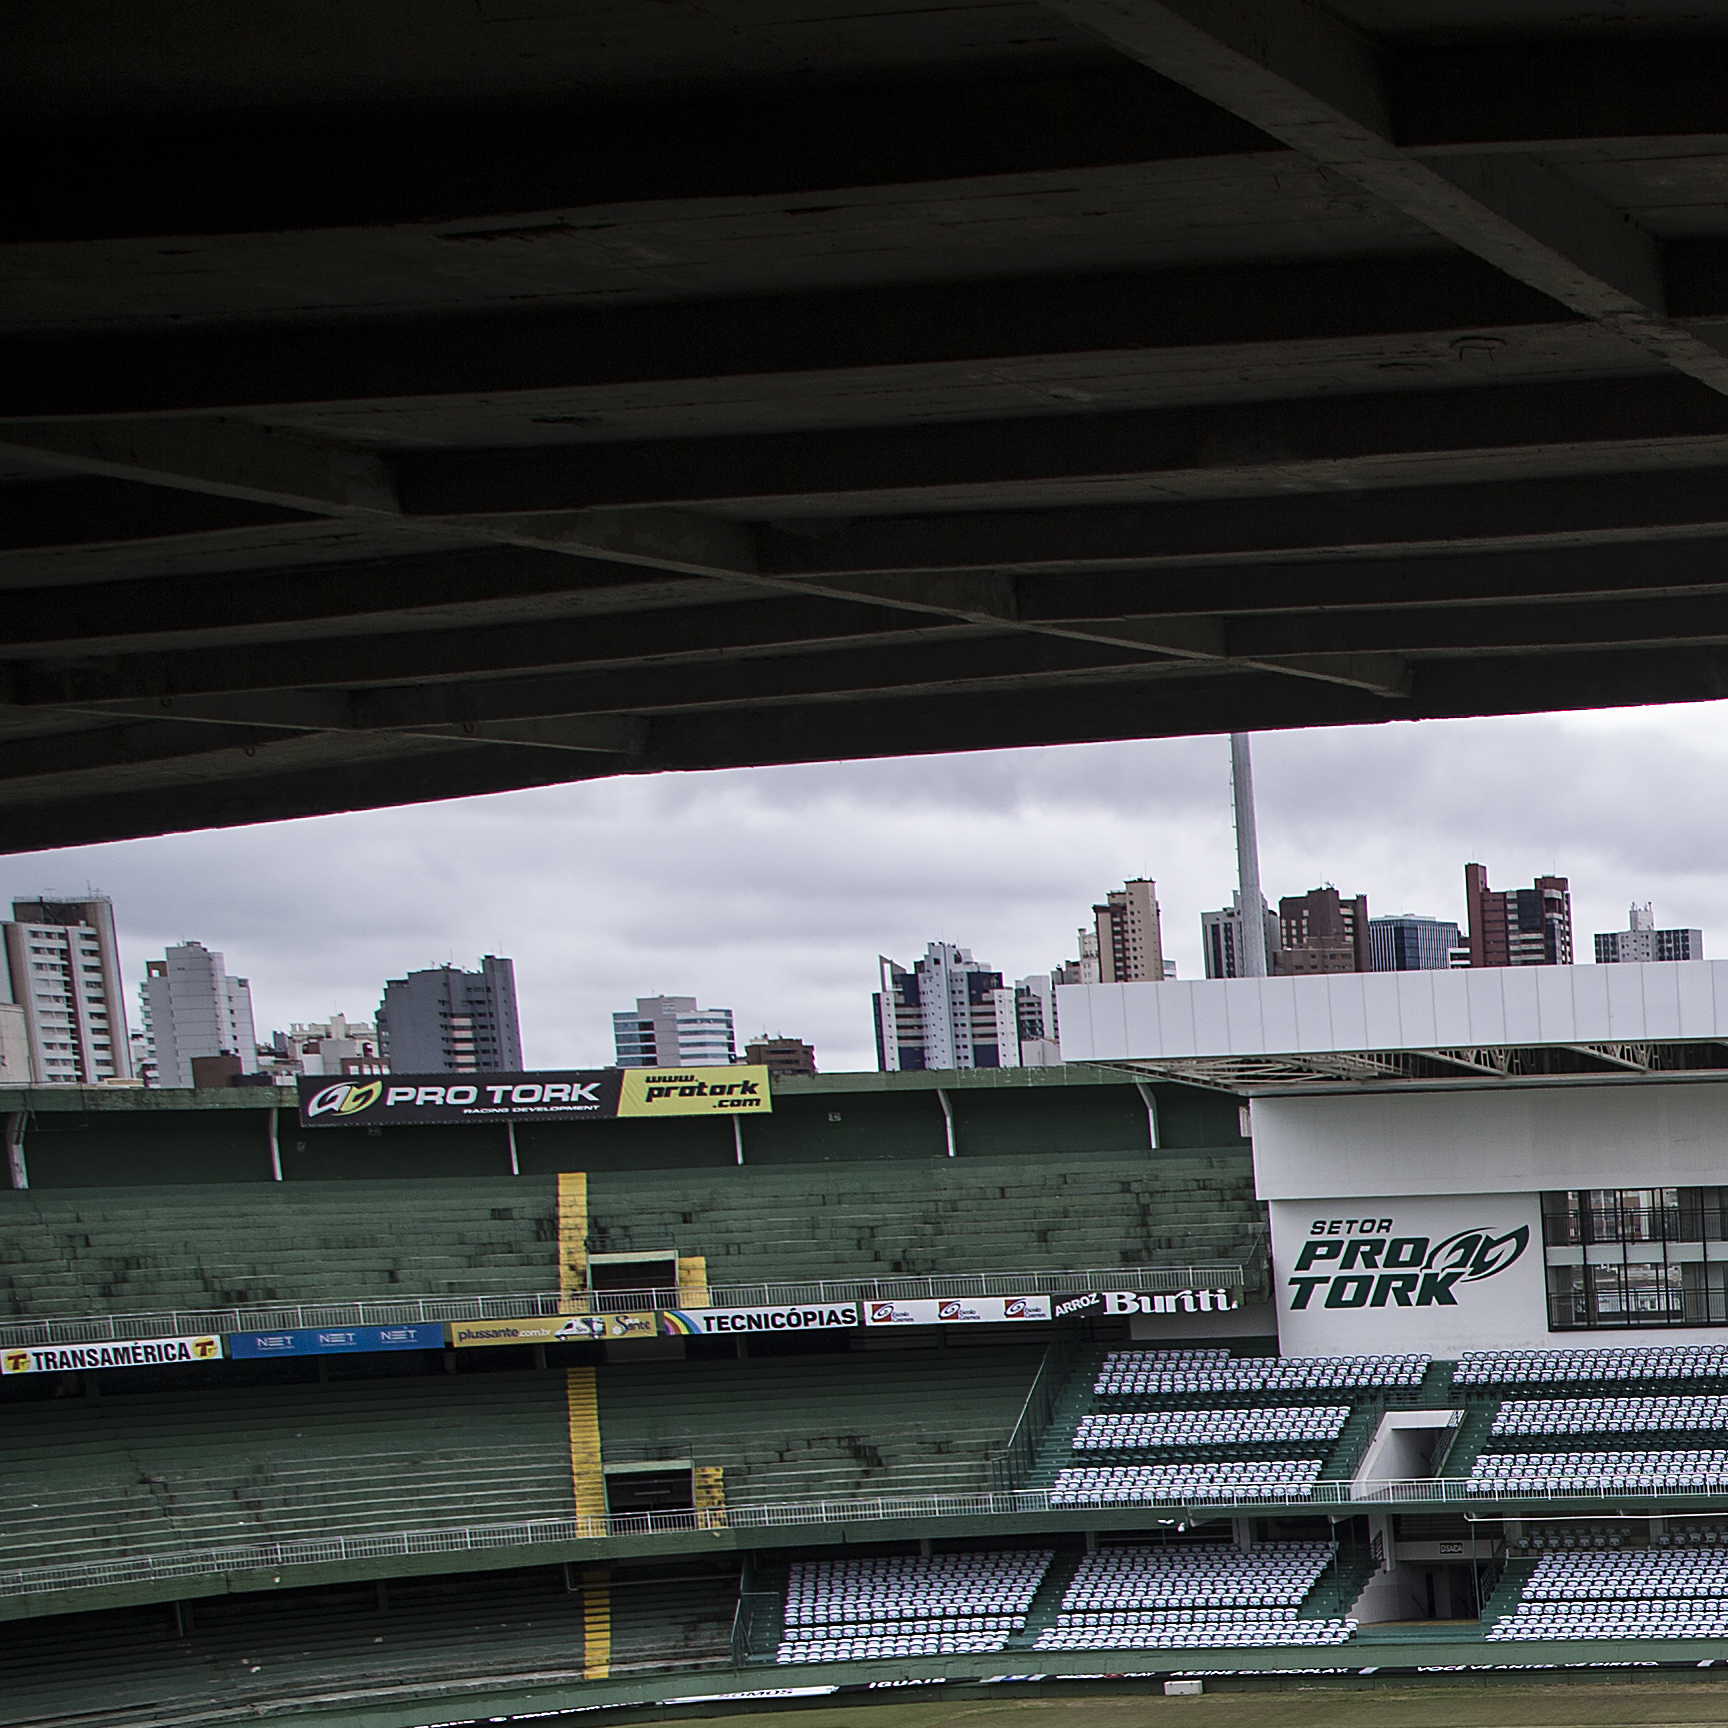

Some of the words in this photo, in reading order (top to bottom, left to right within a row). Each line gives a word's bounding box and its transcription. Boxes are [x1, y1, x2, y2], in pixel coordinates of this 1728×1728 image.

[645, 1073, 699, 1084] www.
[385, 1084, 478, 1106] PRO
[486, 1082, 602, 1105] TORK
[645, 1079, 760, 1104] protork
[712, 1097, 762, 1109] .com
[463, 1106, 510, 1115] RACING
[512, 1104, 600, 1114] DEVELOPMENT
[1310, 1218, 1393, 1235] SETOR
[1293, 1237, 1430, 1272] PRO
[1287, 1270, 1467, 1310] TORK
[1053, 1292, 1100, 1317] ARROZ
[703, 1307, 856, 1332] TECNICÓPIAS
[32, 1342, 191, 1371] TRANSAMÉRICA
